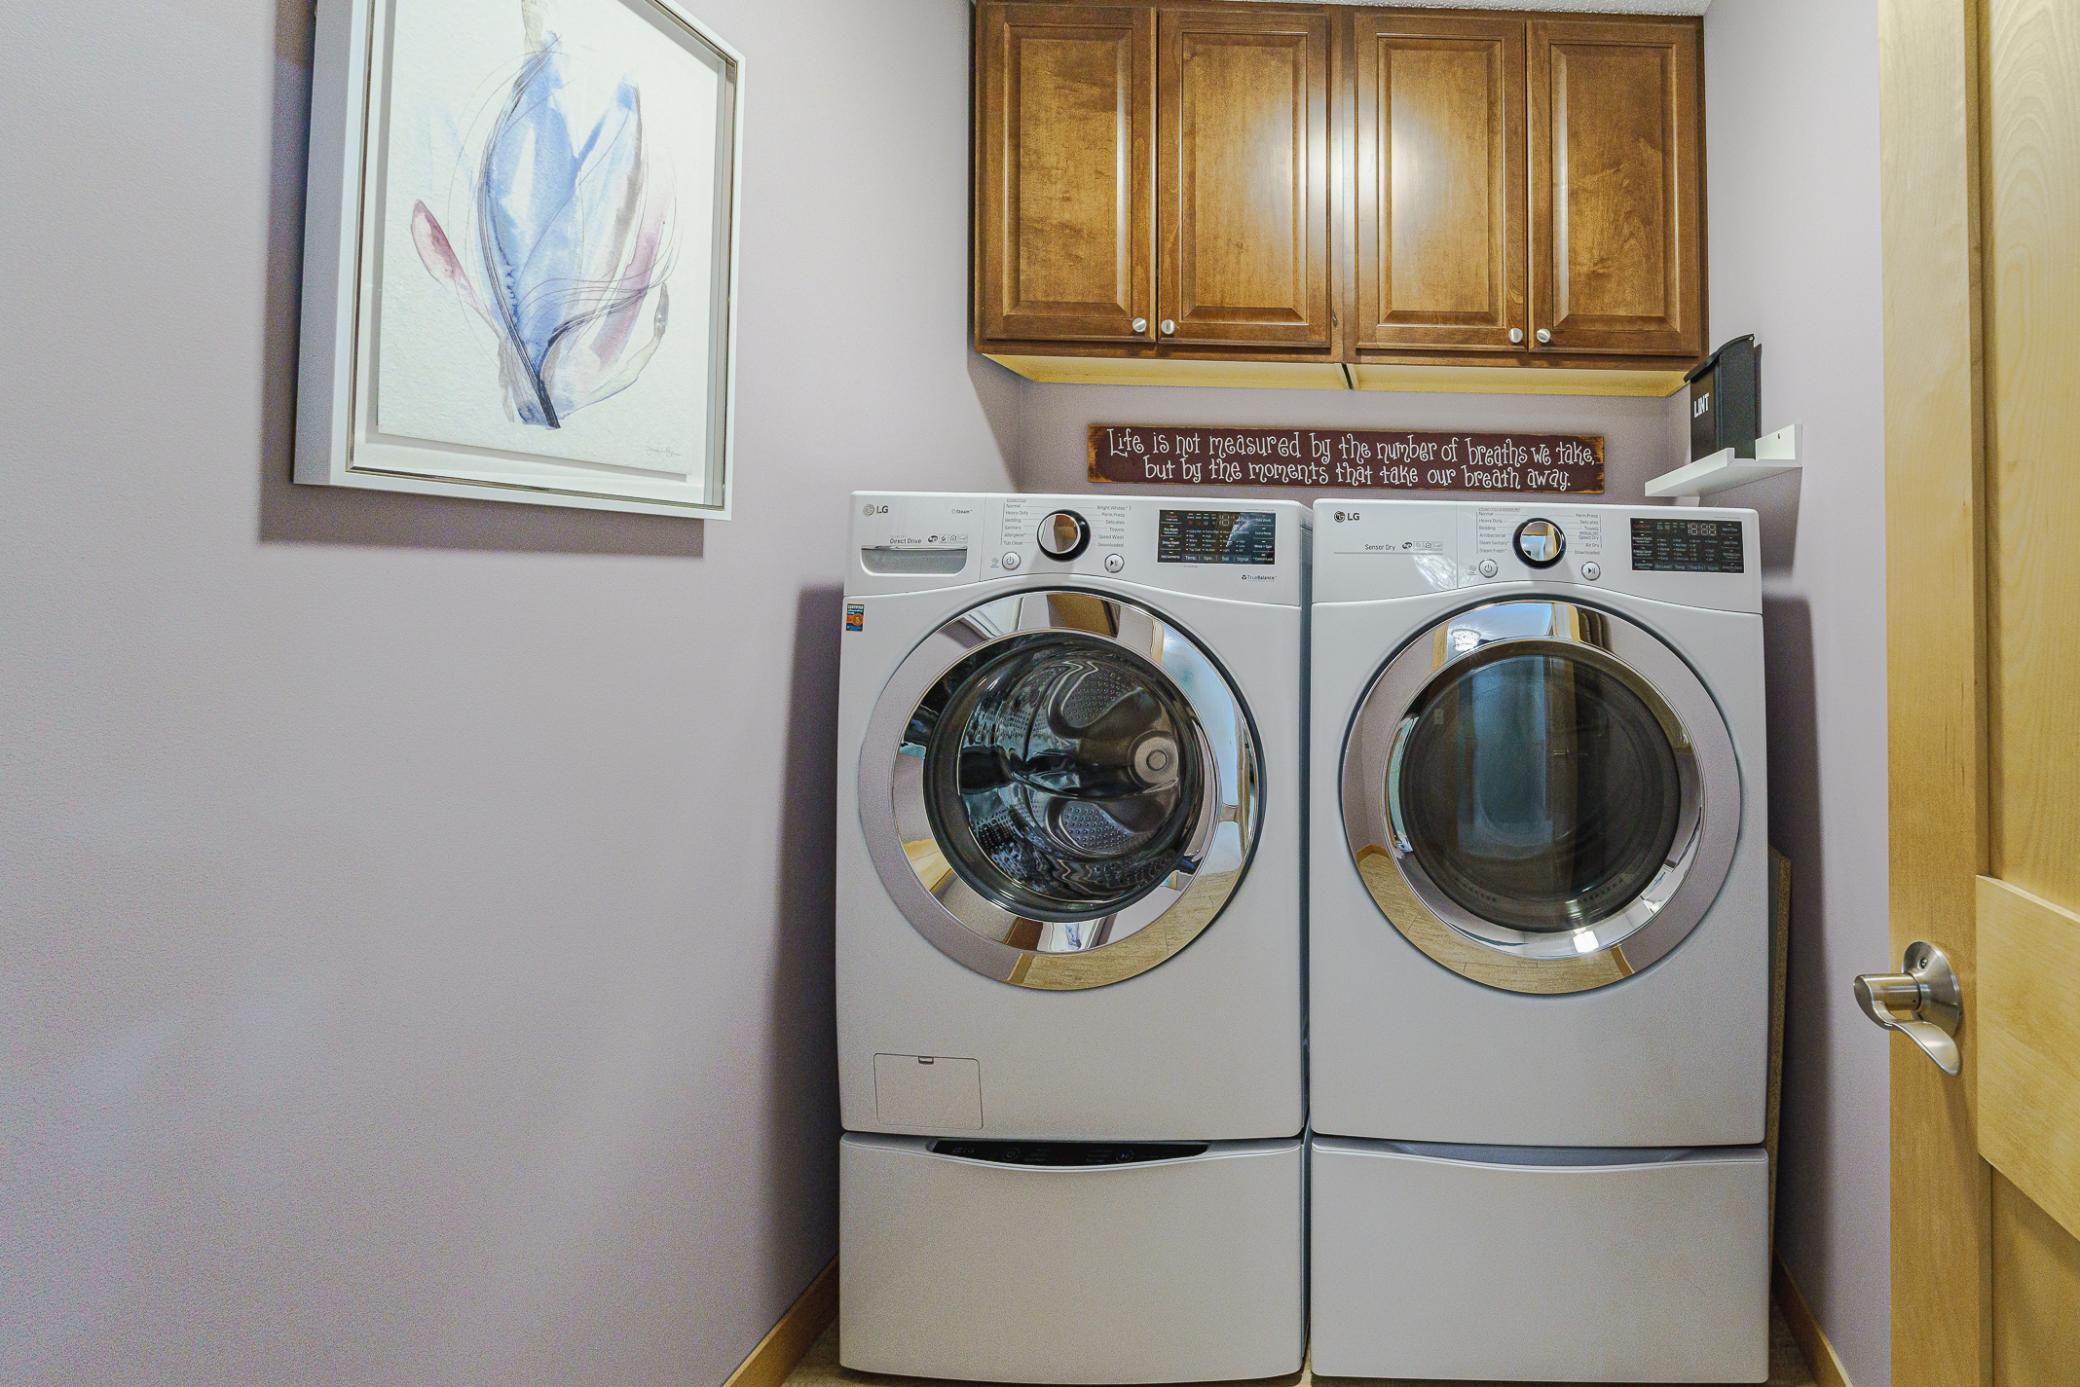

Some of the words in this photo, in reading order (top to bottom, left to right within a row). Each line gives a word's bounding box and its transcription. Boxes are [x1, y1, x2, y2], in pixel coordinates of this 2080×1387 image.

[1694, 392, 1710, 418] LINT
[1106, 428, 1144, 458] Life
[1152, 432, 1169, 454] is
[1175, 432, 1201, 458] not
[1209, 431, 1301, 459] measured
[1308, 432, 1331, 464] by
[1338, 433, 1371, 464] the
[1376, 435, 1437, 464] number
[1441, 437, 1459, 462] of
[1464, 437, 1528, 467] breaths
[1531, 444, 1551, 465] we
[1556, 442, 1596, 466] take,
[1143, 455, 1175, 480] but
[1180, 455, 1201, 483] by
[1209, 458, 1242, 483] the
[1248, 461, 1329, 485] moments
[1335, 462, 1373, 487] that
[1379, 465, 1419, 487] take
[1427, 469, 1457, 485] our
[1461, 464, 1521, 489] breath
[1527, 469, 1572, 491] away.
[876, 505, 889, 514] LG
[1347, 512, 1360, 521] LG
[1364, 543, 1385, 551] Sensor
[1385, 544, 1396, 552] Dry
